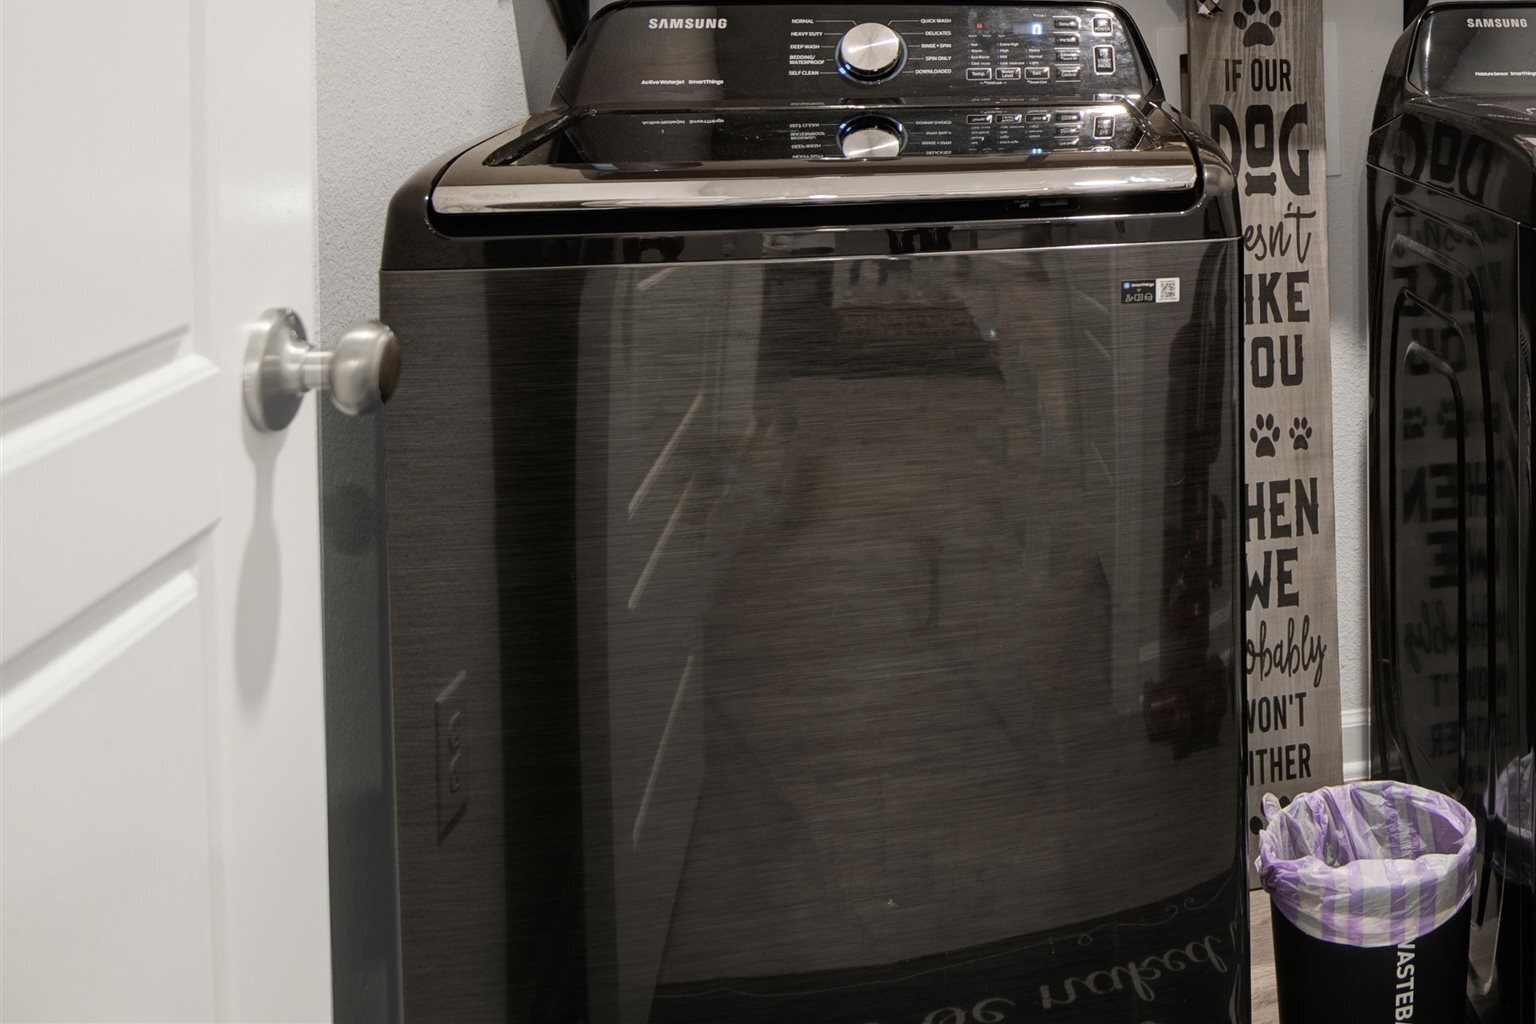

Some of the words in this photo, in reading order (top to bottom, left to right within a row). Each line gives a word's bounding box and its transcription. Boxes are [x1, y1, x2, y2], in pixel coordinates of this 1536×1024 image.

[648, 18, 728, 29] SAMSUNG
[1466, 18, 1528, 28] SAMSUNG
[1224, 58, 1242, 92] IF
[1251, 58, 1292, 92] OUR
[1209, 102, 1310, 196] DOG
[1244, 201, 1316, 264] esn't
[1244, 270, 1310, 325] IKE
[1244, 335, 1304, 388] OU
[1245, 477, 1319, 541] HEN
[1246, 546, 1300, 611] WE
[1246, 614, 1327, 688] obably
[1248, 743, 1312, 786] ITHER
[1394, 944, 1416, 1024] ASTEB
